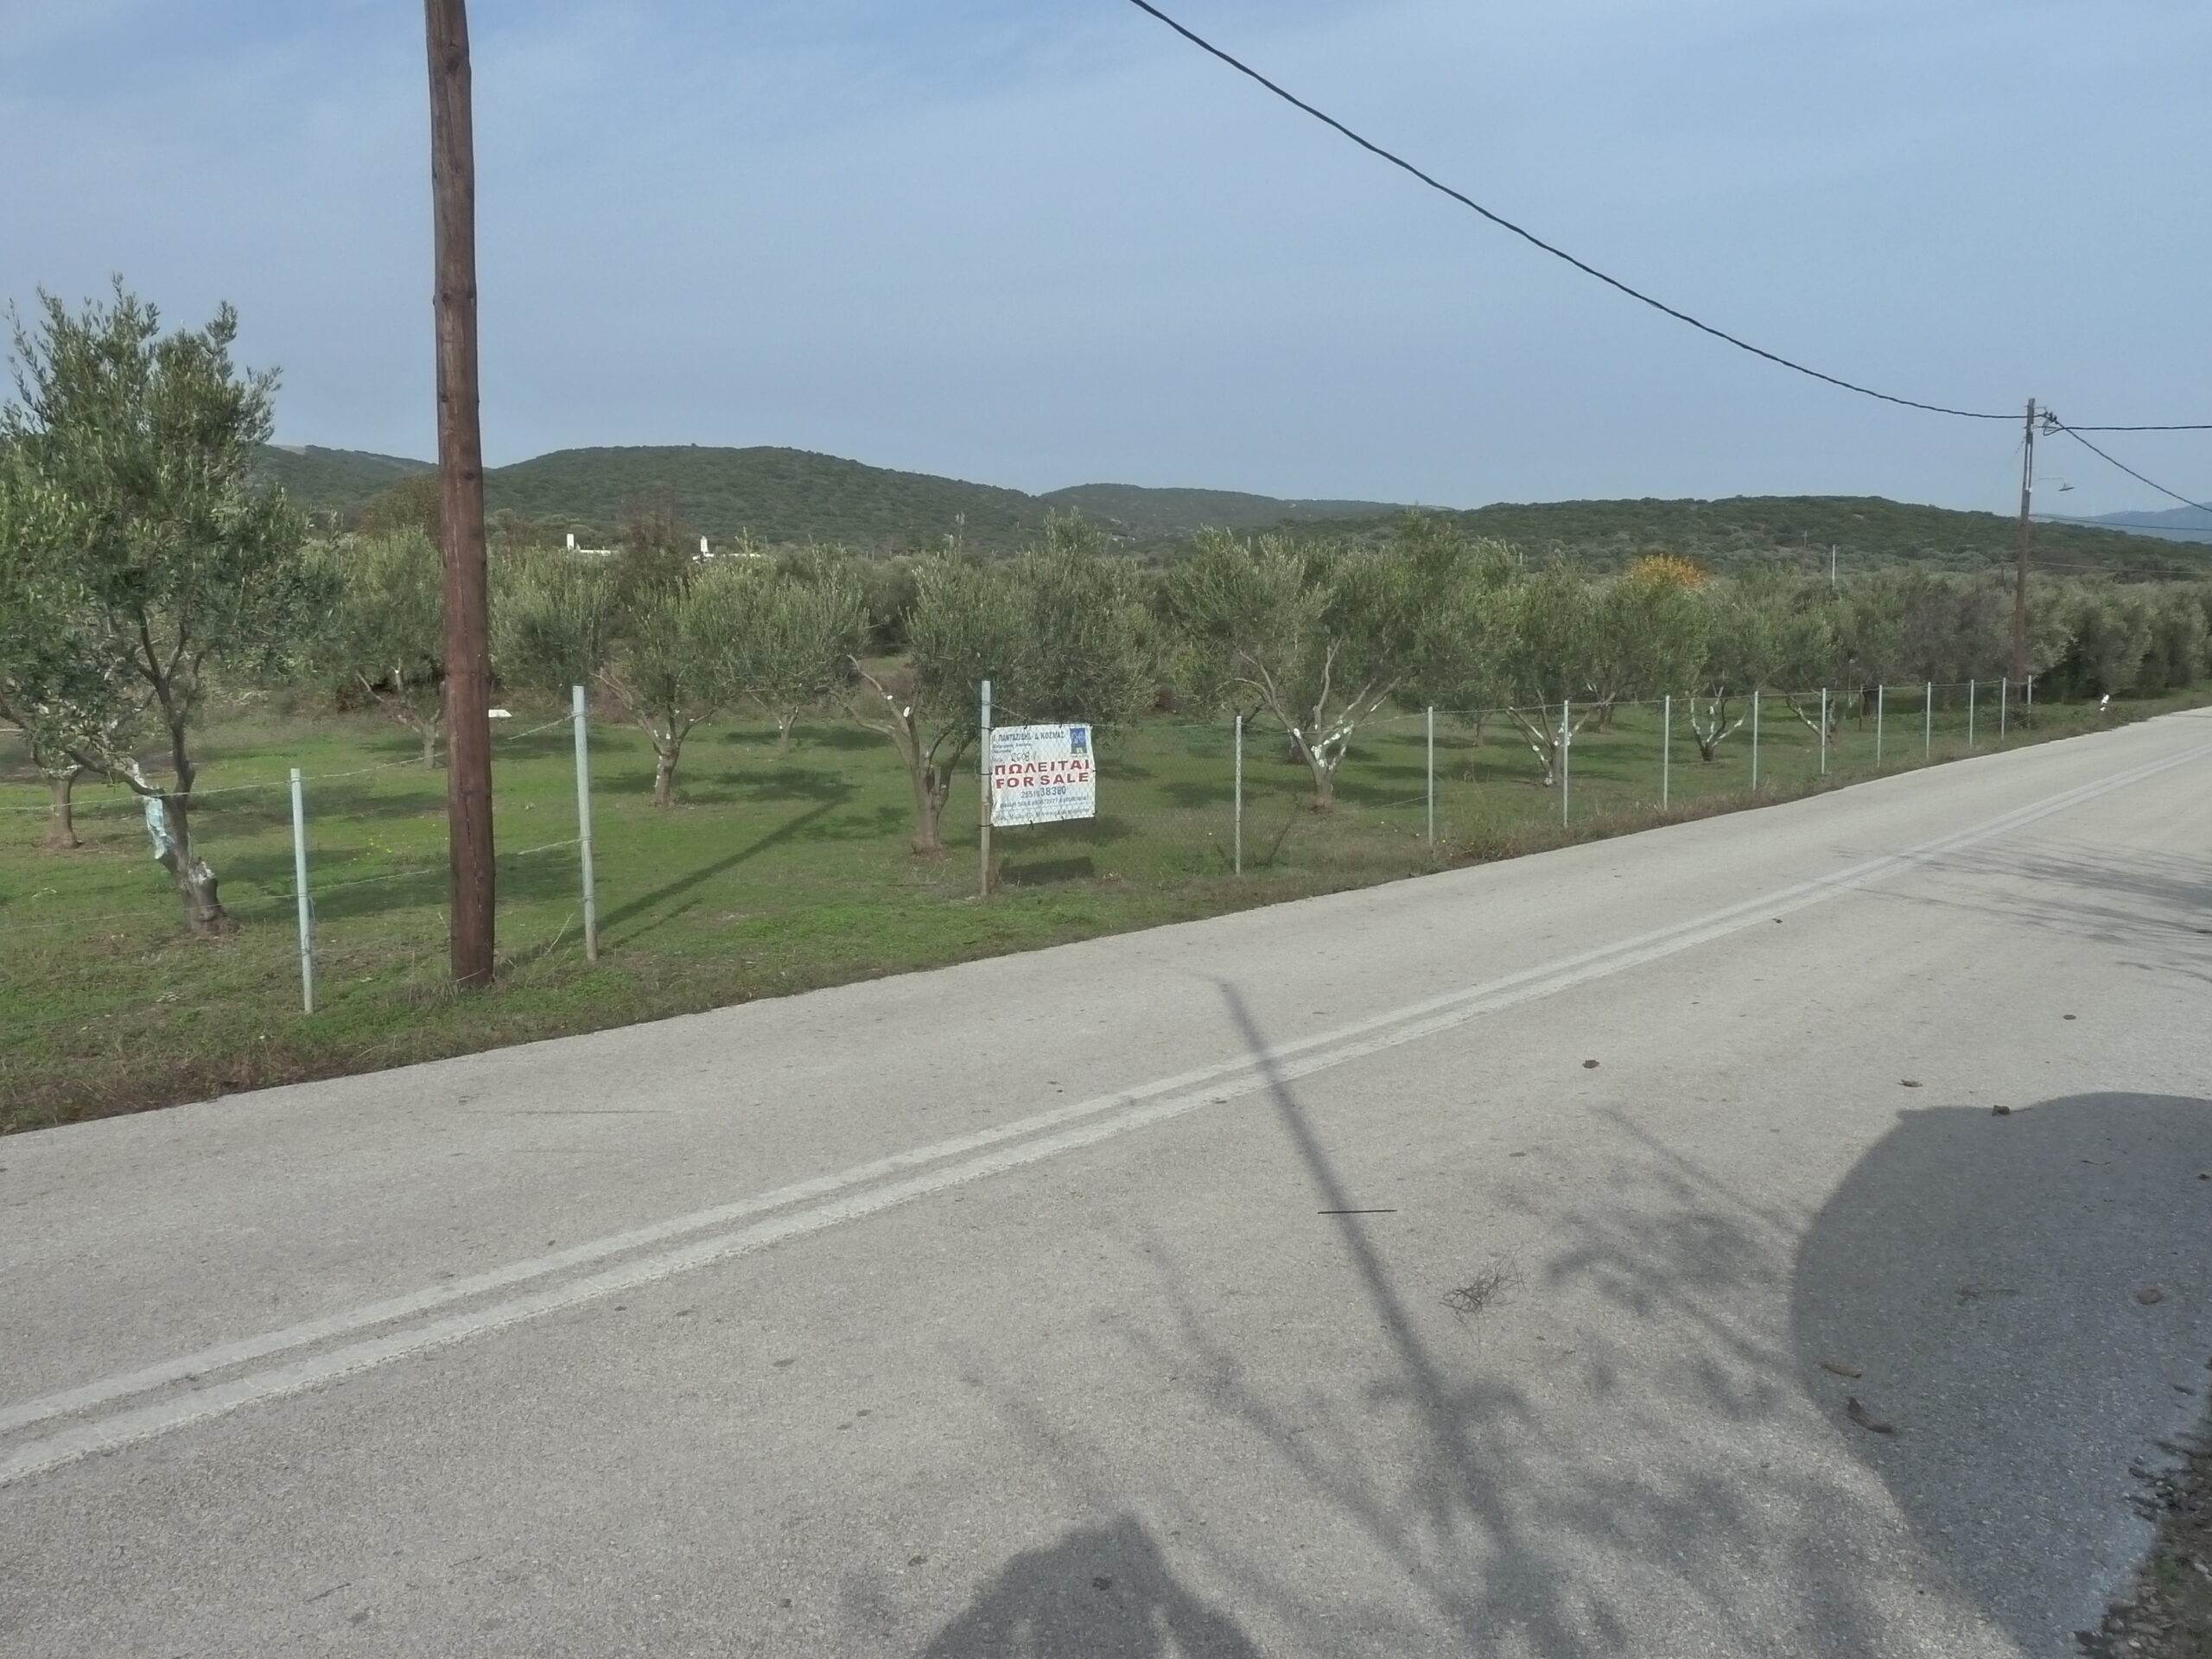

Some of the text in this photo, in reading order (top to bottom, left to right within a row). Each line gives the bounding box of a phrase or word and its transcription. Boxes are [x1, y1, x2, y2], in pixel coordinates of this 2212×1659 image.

[995, 760, 1090, 775] ΠΩΛΕΙΤΑΙ
[996, 772, 1089, 789] FOR SALE
